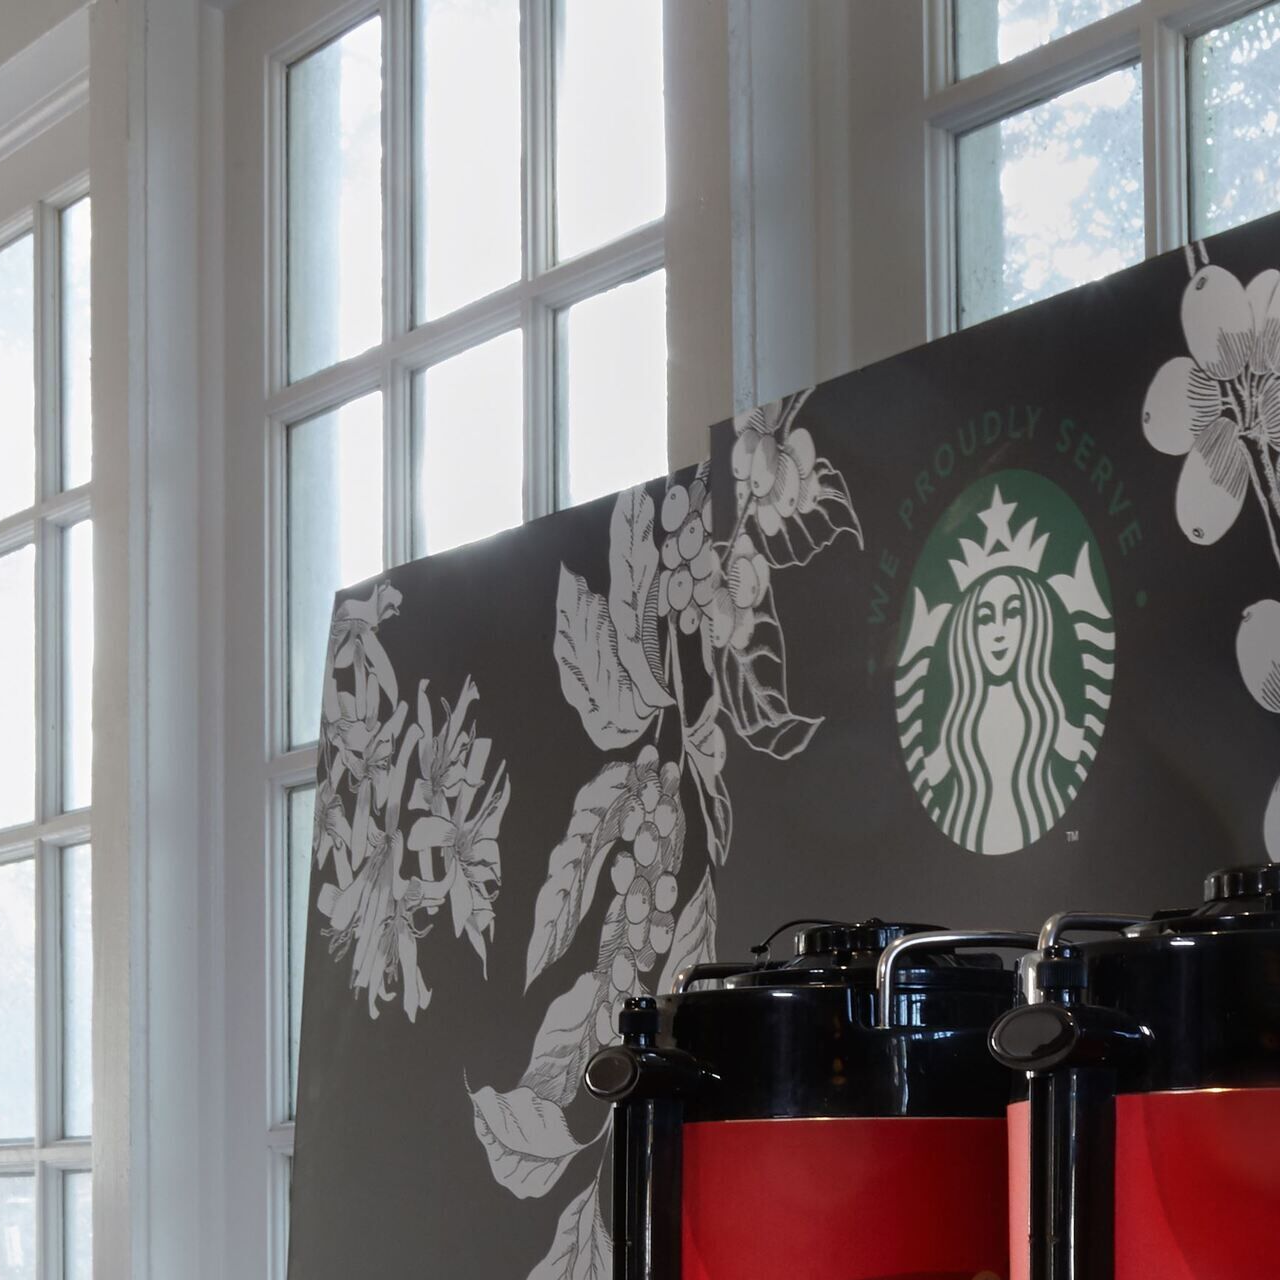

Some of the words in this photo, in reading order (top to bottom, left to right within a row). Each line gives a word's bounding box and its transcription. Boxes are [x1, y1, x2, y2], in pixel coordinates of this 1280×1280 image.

[867, 547, 901, 627] WE
[897, 404, 1043, 532] PROUDLY
[1054, 417, 1145, 557] SERVE
